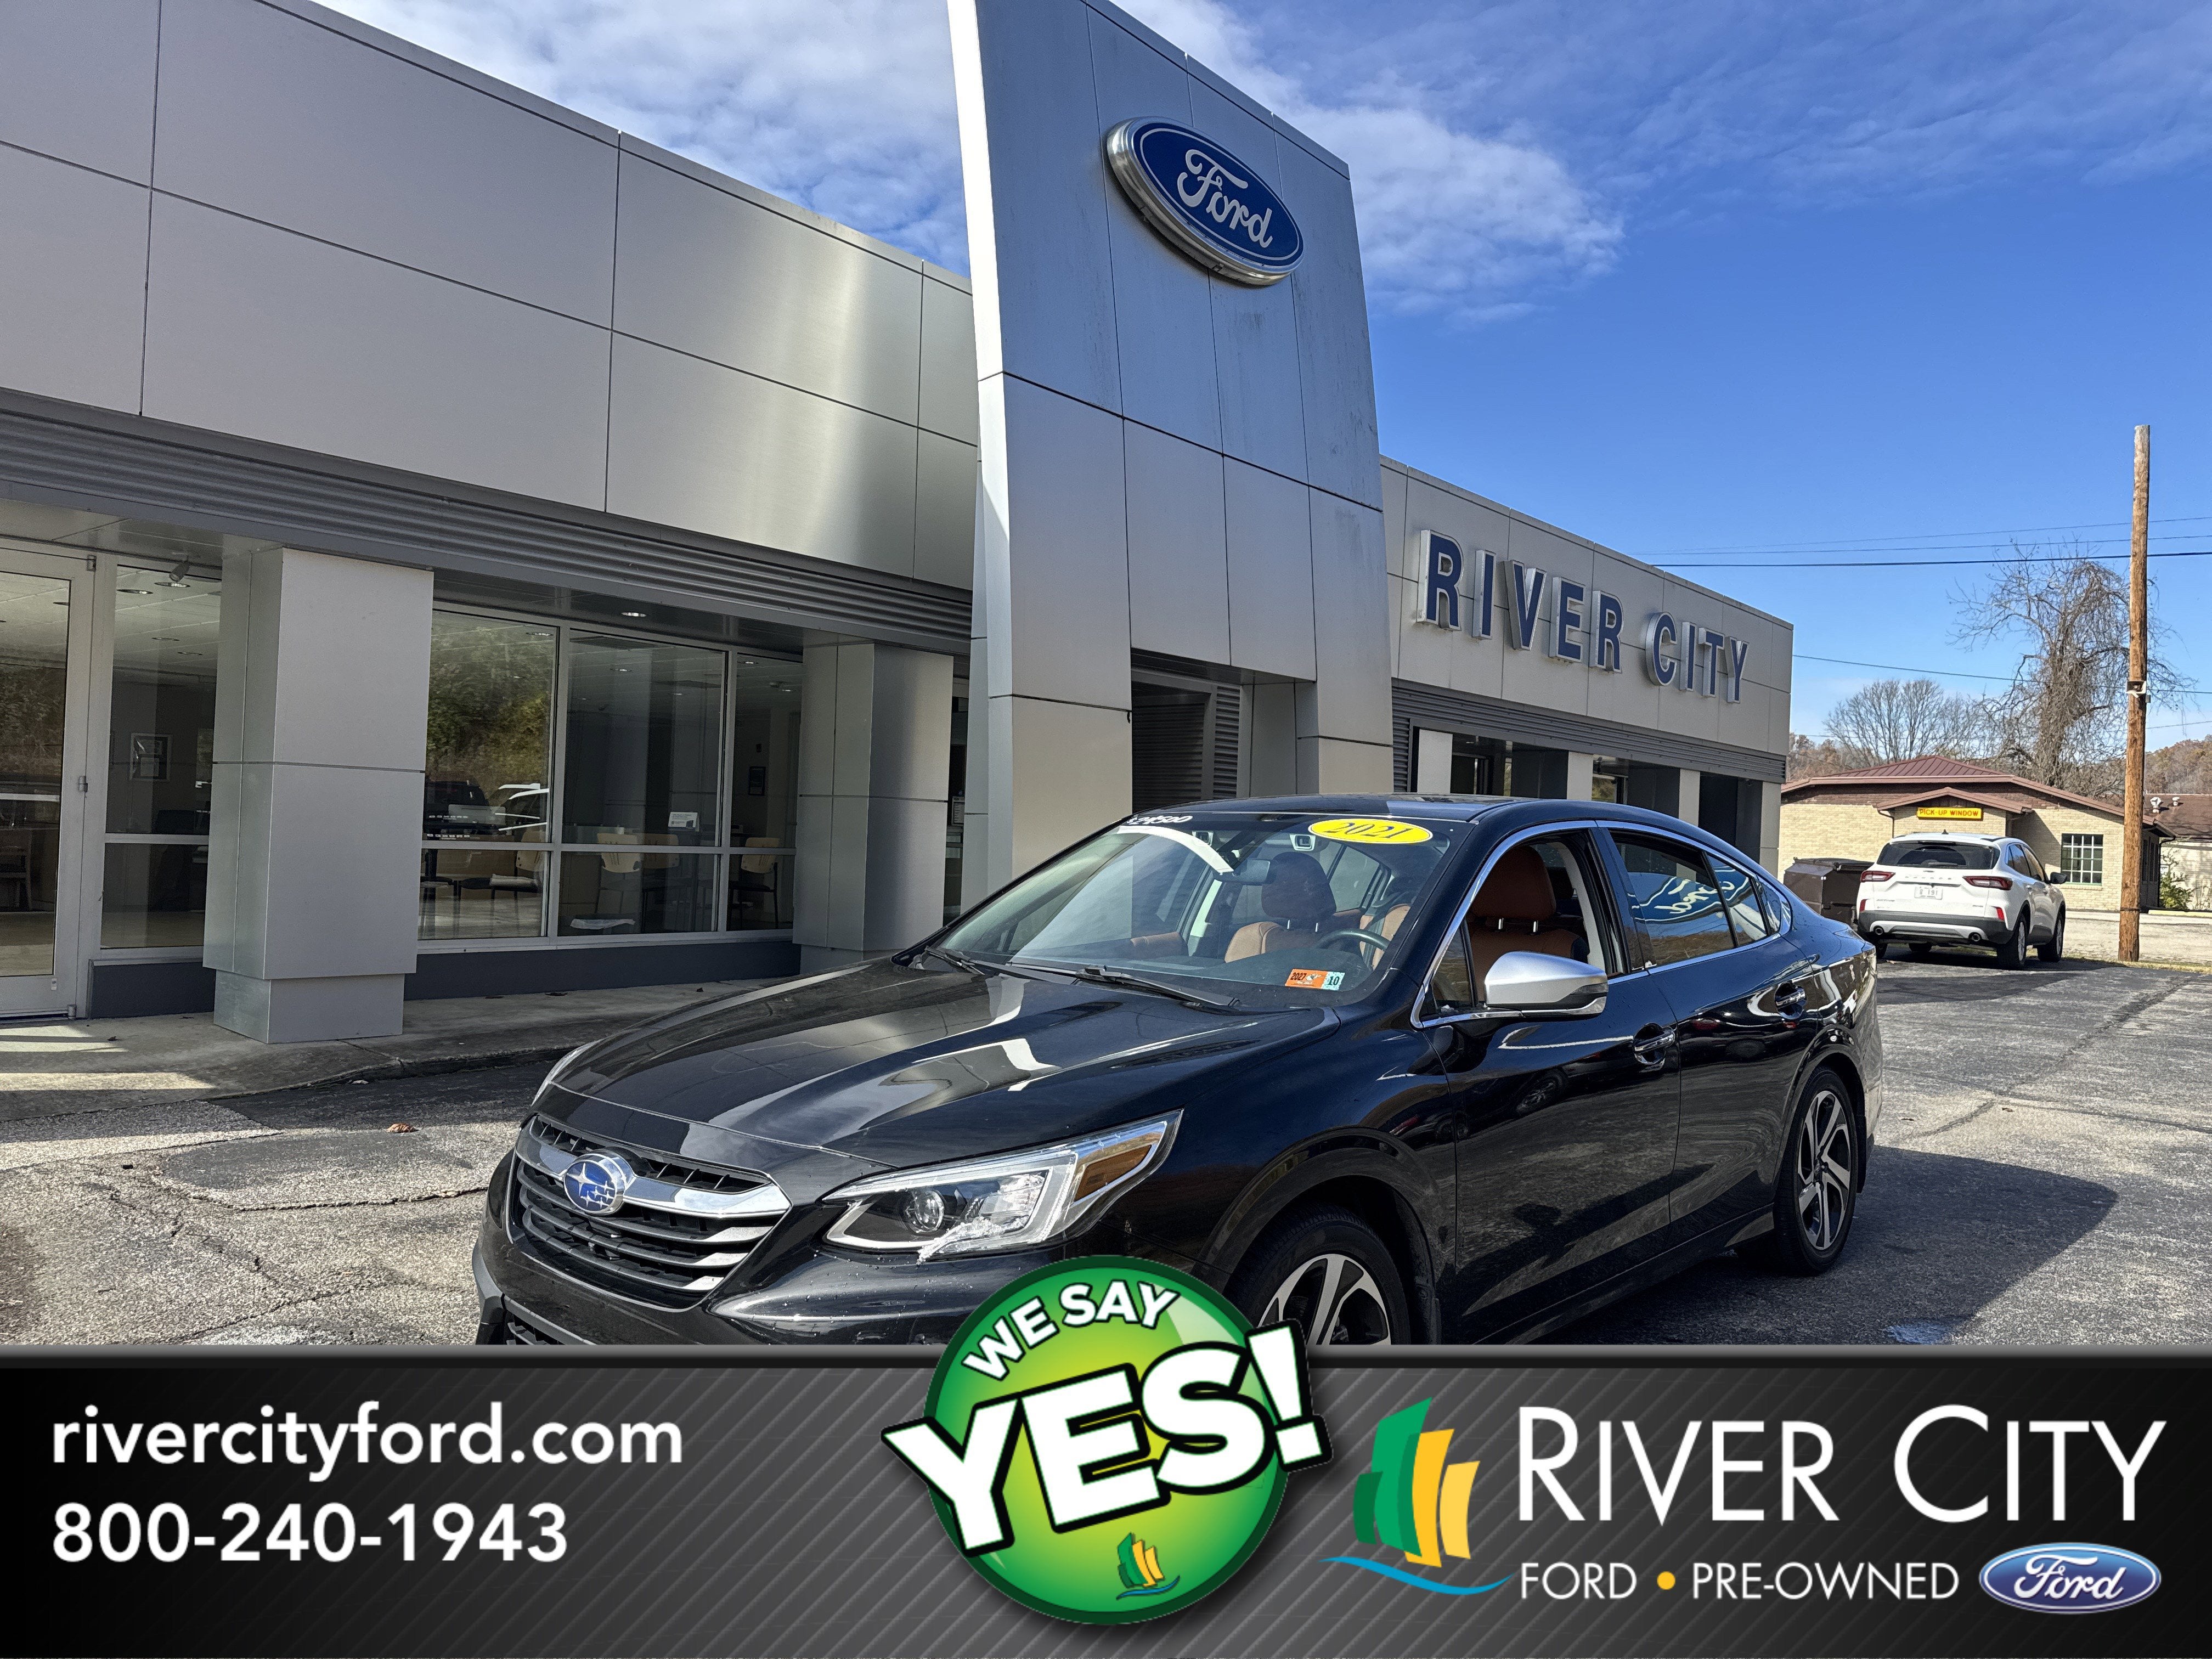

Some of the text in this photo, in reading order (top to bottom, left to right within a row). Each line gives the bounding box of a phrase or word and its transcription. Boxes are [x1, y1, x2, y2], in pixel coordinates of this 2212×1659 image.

[1177, 149, 1273, 248] Ford
[1417, 529, 1750, 704] RIVER CITY
[1322, 822, 1413, 839] 2021
[1290, 972, 1307, 981] 2027
[1328, 976, 1340, 986] 10
